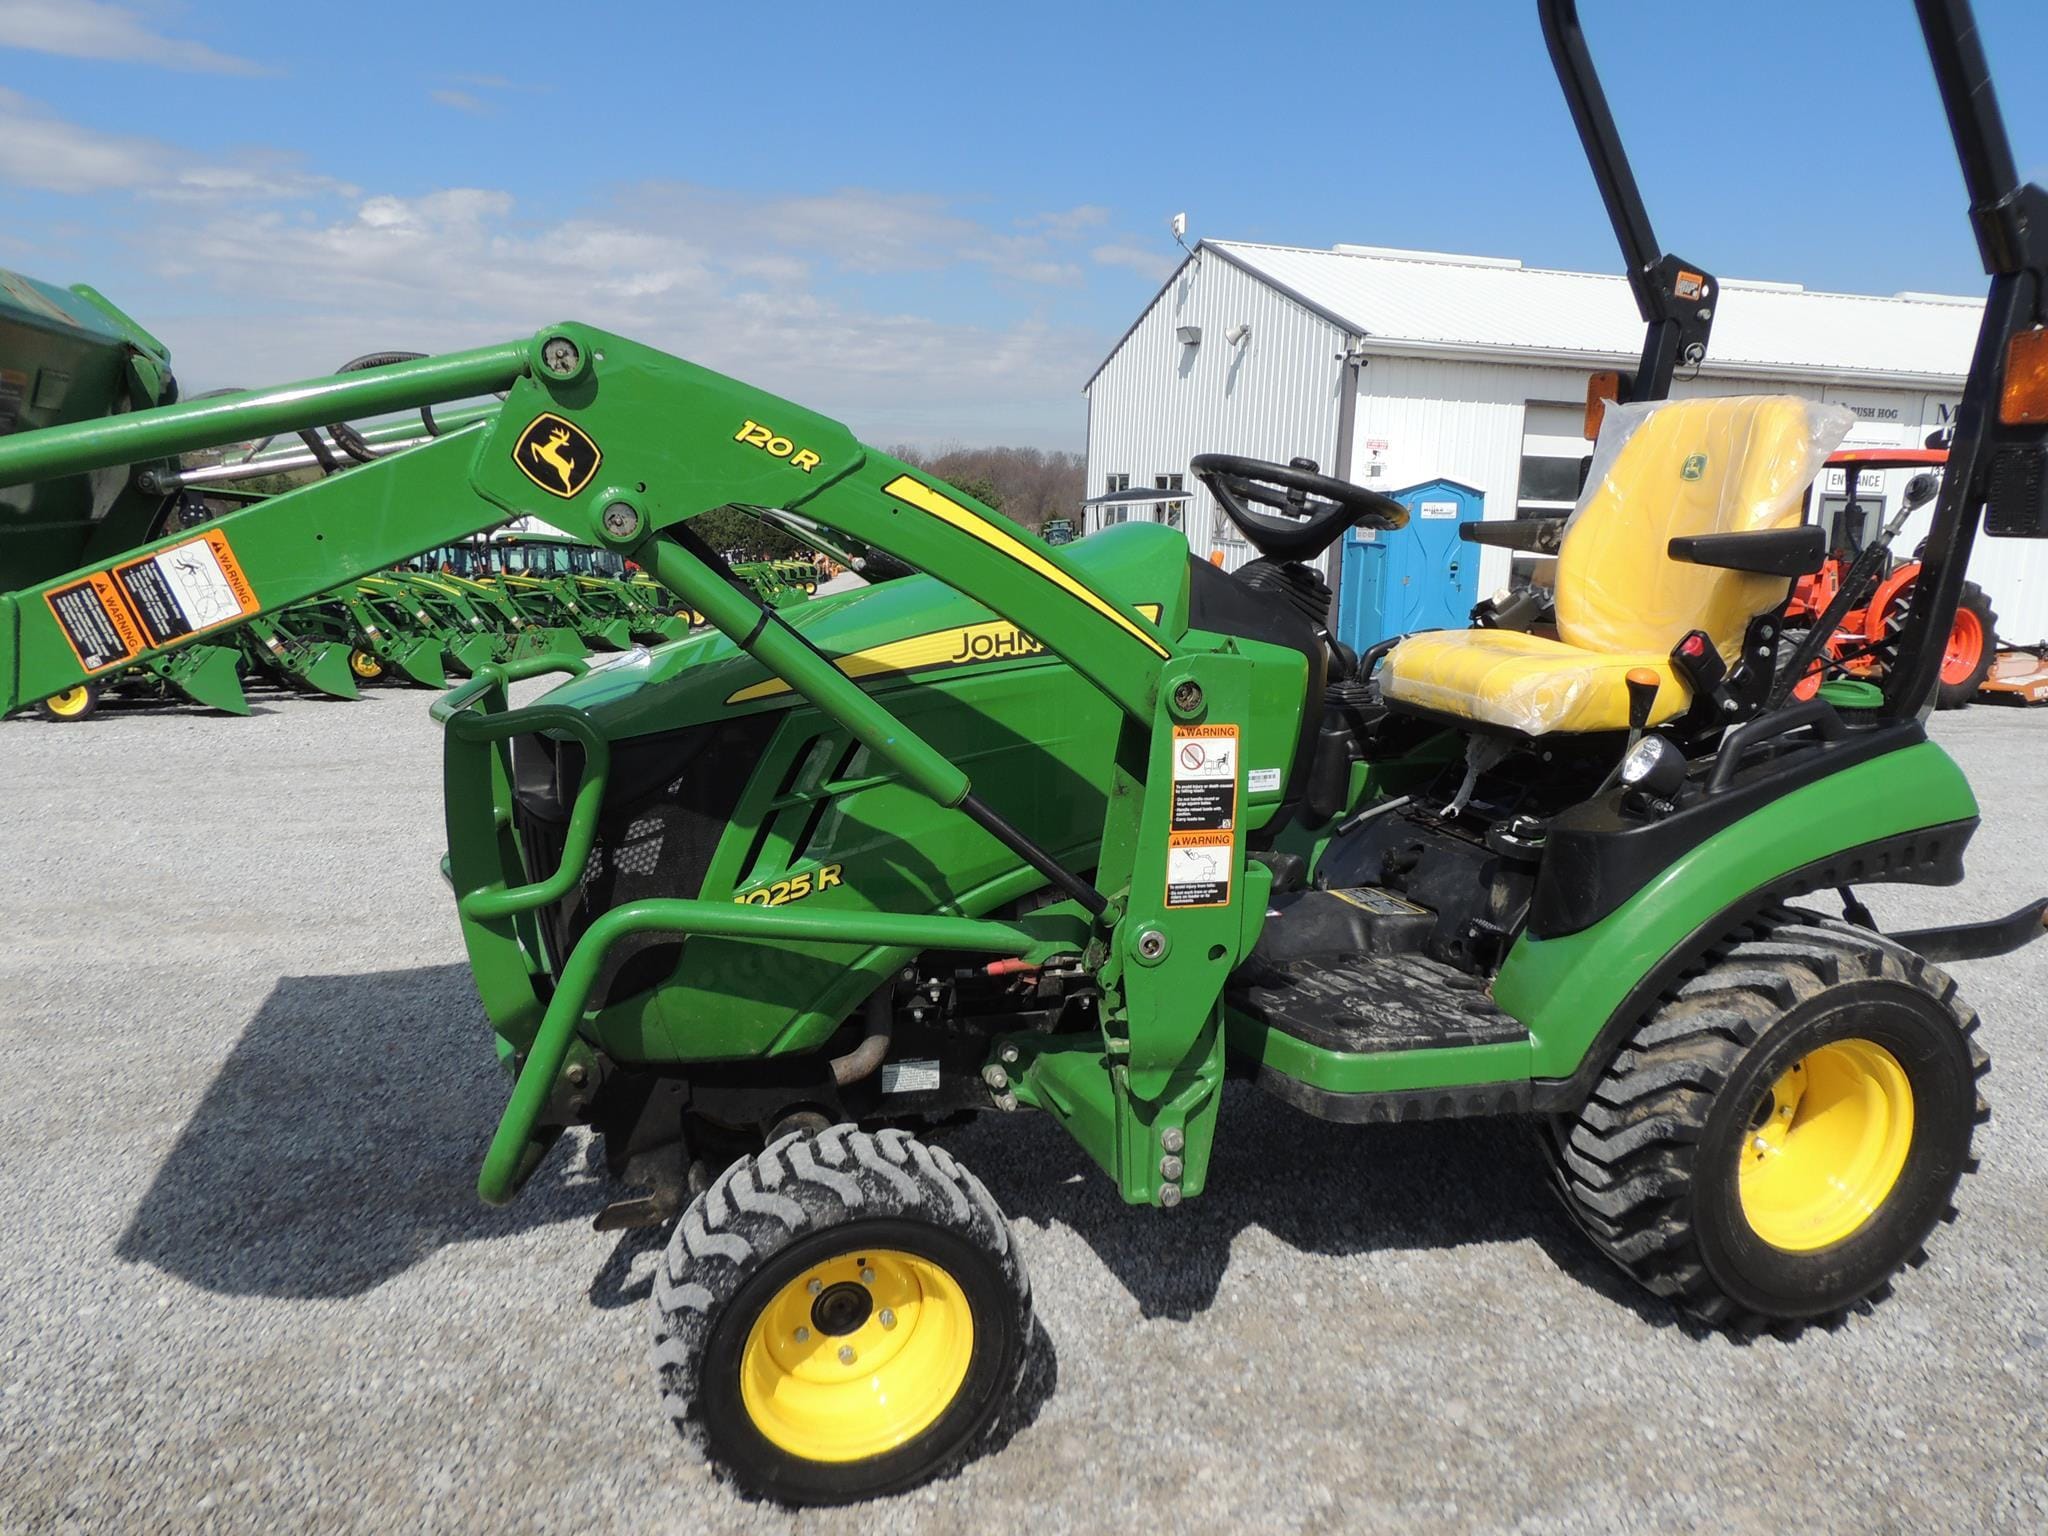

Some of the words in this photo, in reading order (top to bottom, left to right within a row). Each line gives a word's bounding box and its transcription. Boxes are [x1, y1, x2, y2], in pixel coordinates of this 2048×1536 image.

[1876, 408, 1898, 419] HOG
[1832, 473, 1880, 487] ENANCE
[219, 552, 250, 605] WARNING
[106, 597, 139, 648] WARNING
[952, 631, 1038, 660] JOHN
[1187, 728, 1235, 737] WARNING
[1182, 836, 1230, 846] WARNING
[818, 863, 844, 892] R
